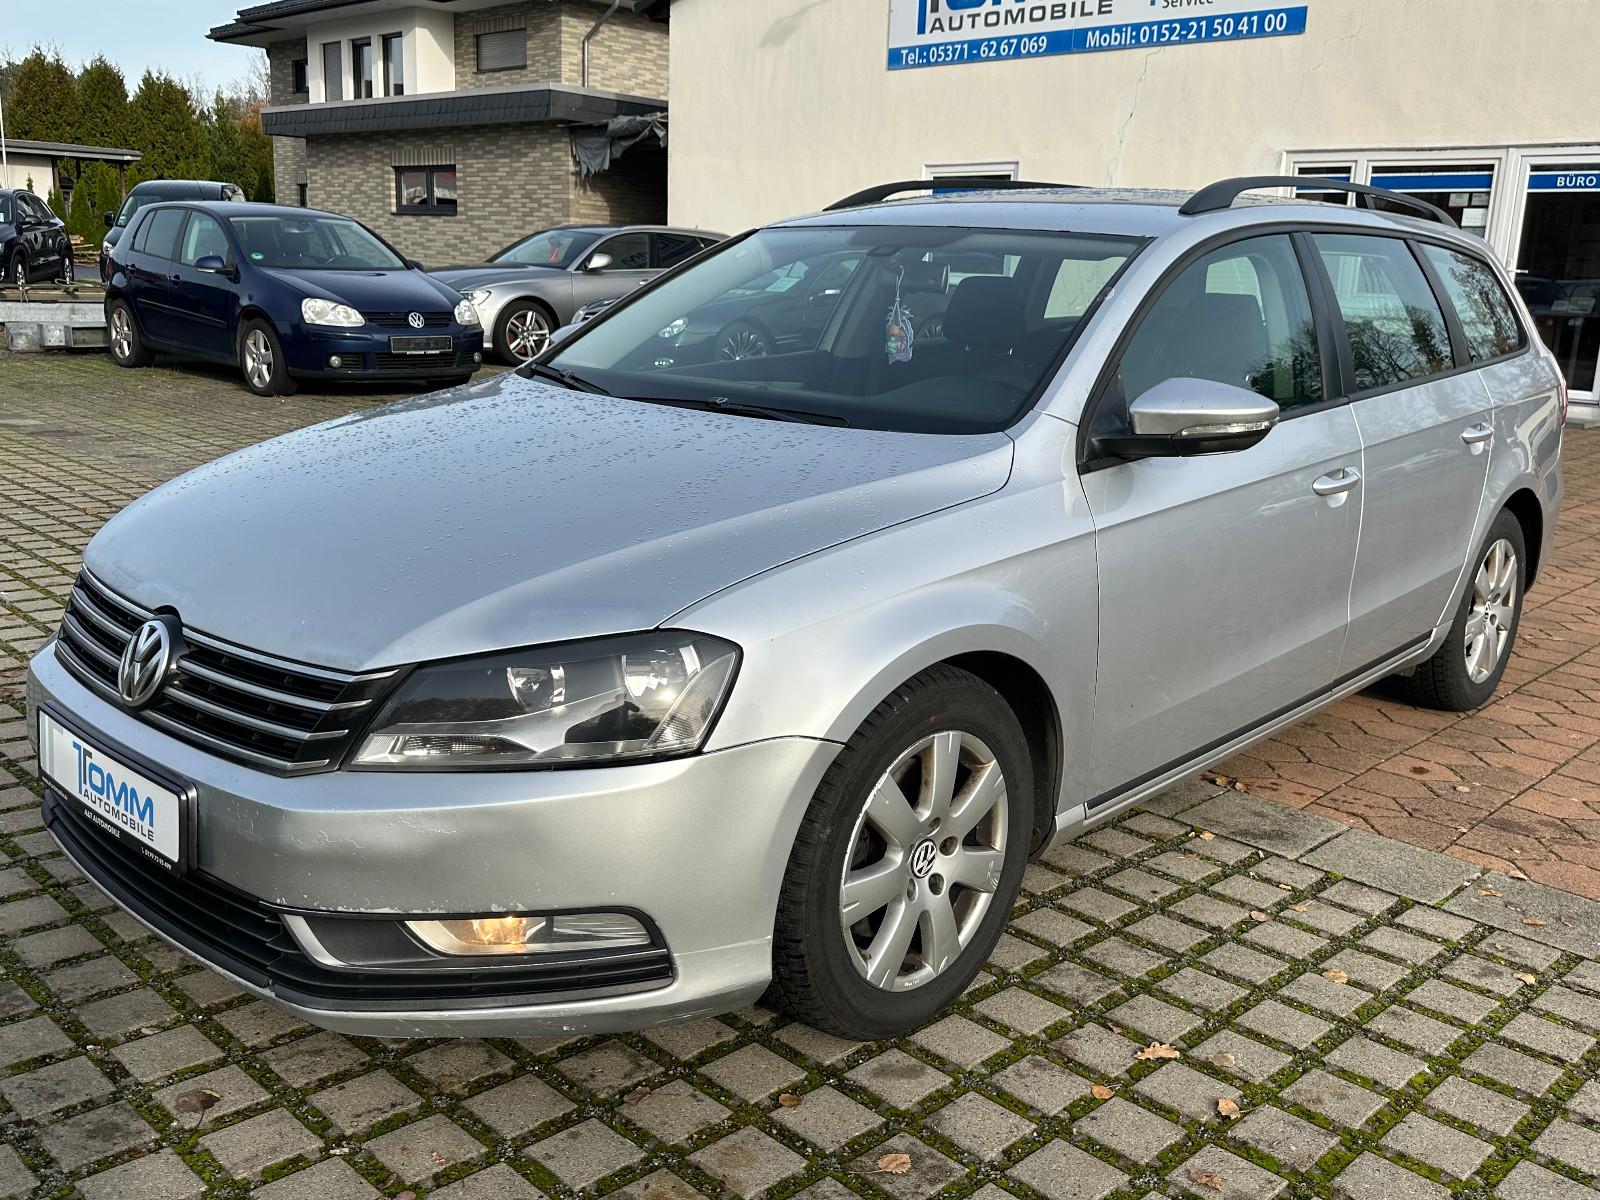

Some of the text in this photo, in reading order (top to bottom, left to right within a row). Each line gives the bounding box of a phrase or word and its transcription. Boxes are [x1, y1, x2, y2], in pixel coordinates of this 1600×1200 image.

[929, 0, 1113, 33] AUTOMOBILE
[1085, 12, 1288, 48] Mobil: 0152-21 50 41 00
[900, 48, 927, 65] Tel.:
[929, 43, 968, 63] 05371
[980, 41, 997, 58] 62
[1000, 38, 1018, 56] 67
[1020, 36, 1048, 54] 069
[1557, 173, 1597, 187] BÜRO
[83, 788, 154, 842] AUTOMOBILE
